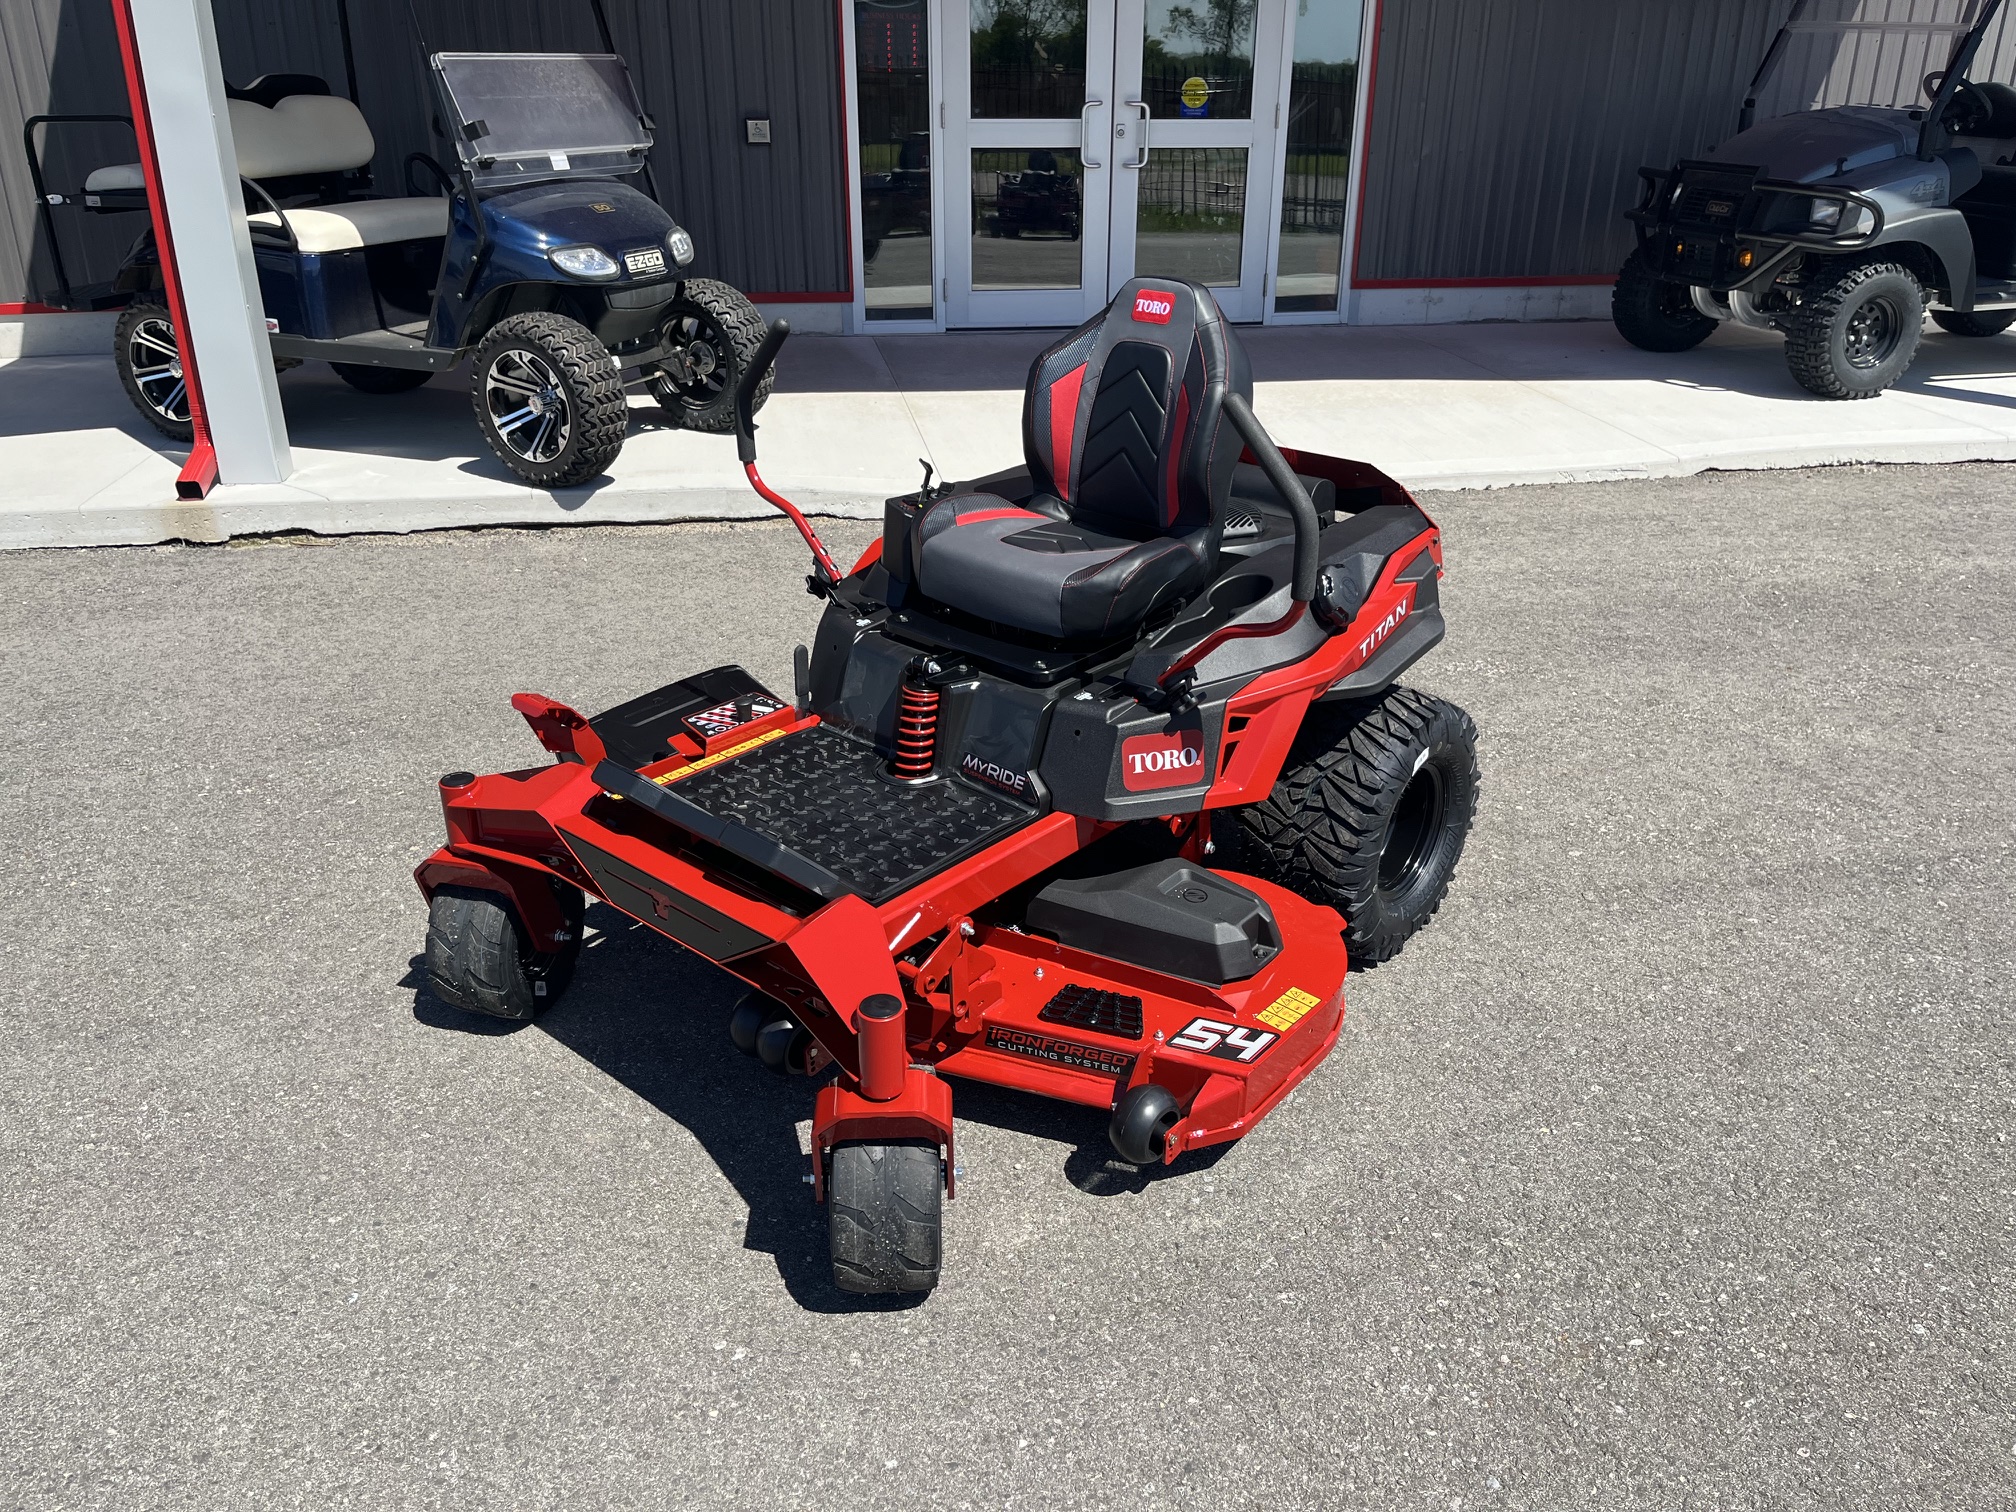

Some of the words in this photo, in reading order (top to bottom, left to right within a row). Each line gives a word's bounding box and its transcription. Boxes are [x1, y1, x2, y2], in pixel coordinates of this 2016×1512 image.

[1136, 299, 1170, 315] TORO
[1359, 599, 1407, 658] TITAN
[1128, 747, 1199, 774] TORO
[1170, 1018, 1277, 1062] 54
[997, 1041, 1058, 1060] CUTTING
[1064, 1055, 1121, 1074] SYSTEM
